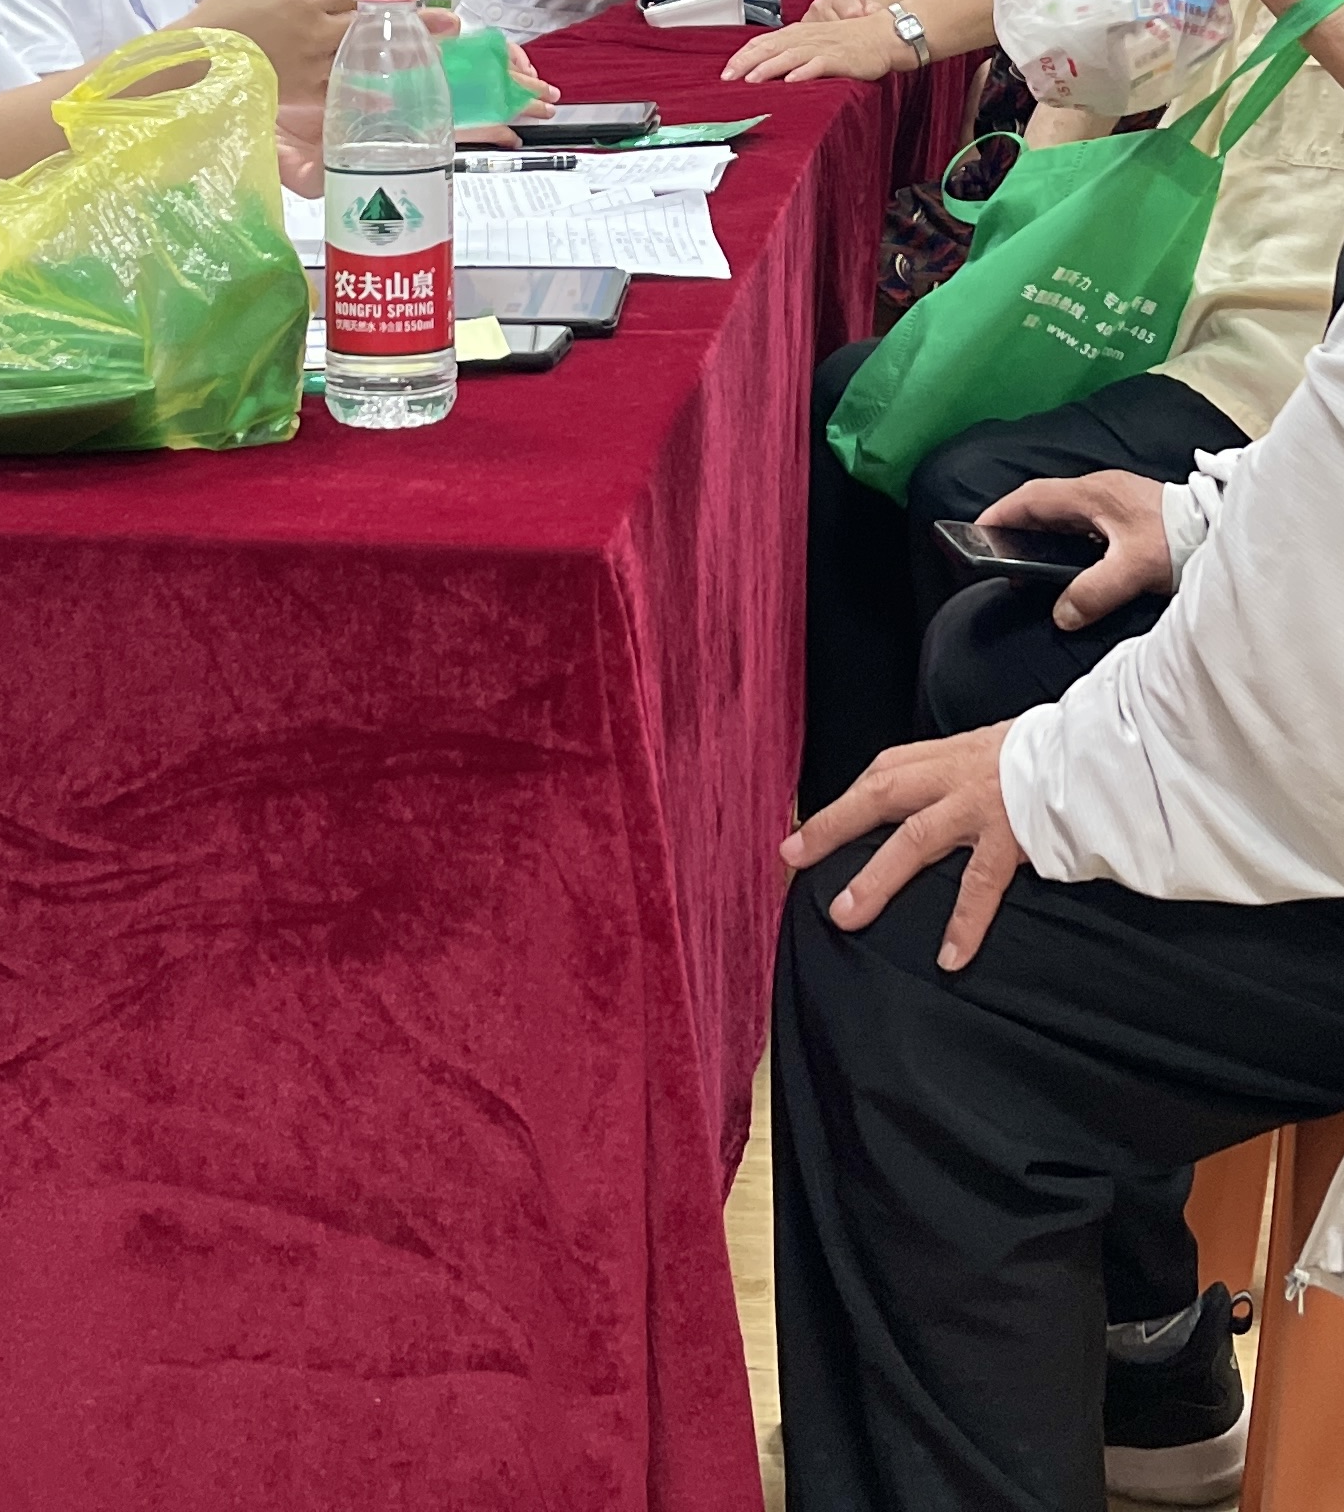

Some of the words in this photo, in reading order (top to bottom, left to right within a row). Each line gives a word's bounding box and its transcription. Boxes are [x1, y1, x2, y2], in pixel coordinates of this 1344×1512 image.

[335, 270, 434, 301] 农夫山泉
[335, 301, 382, 318] NONGFU
[387, 301, 434, 318] SPRING
